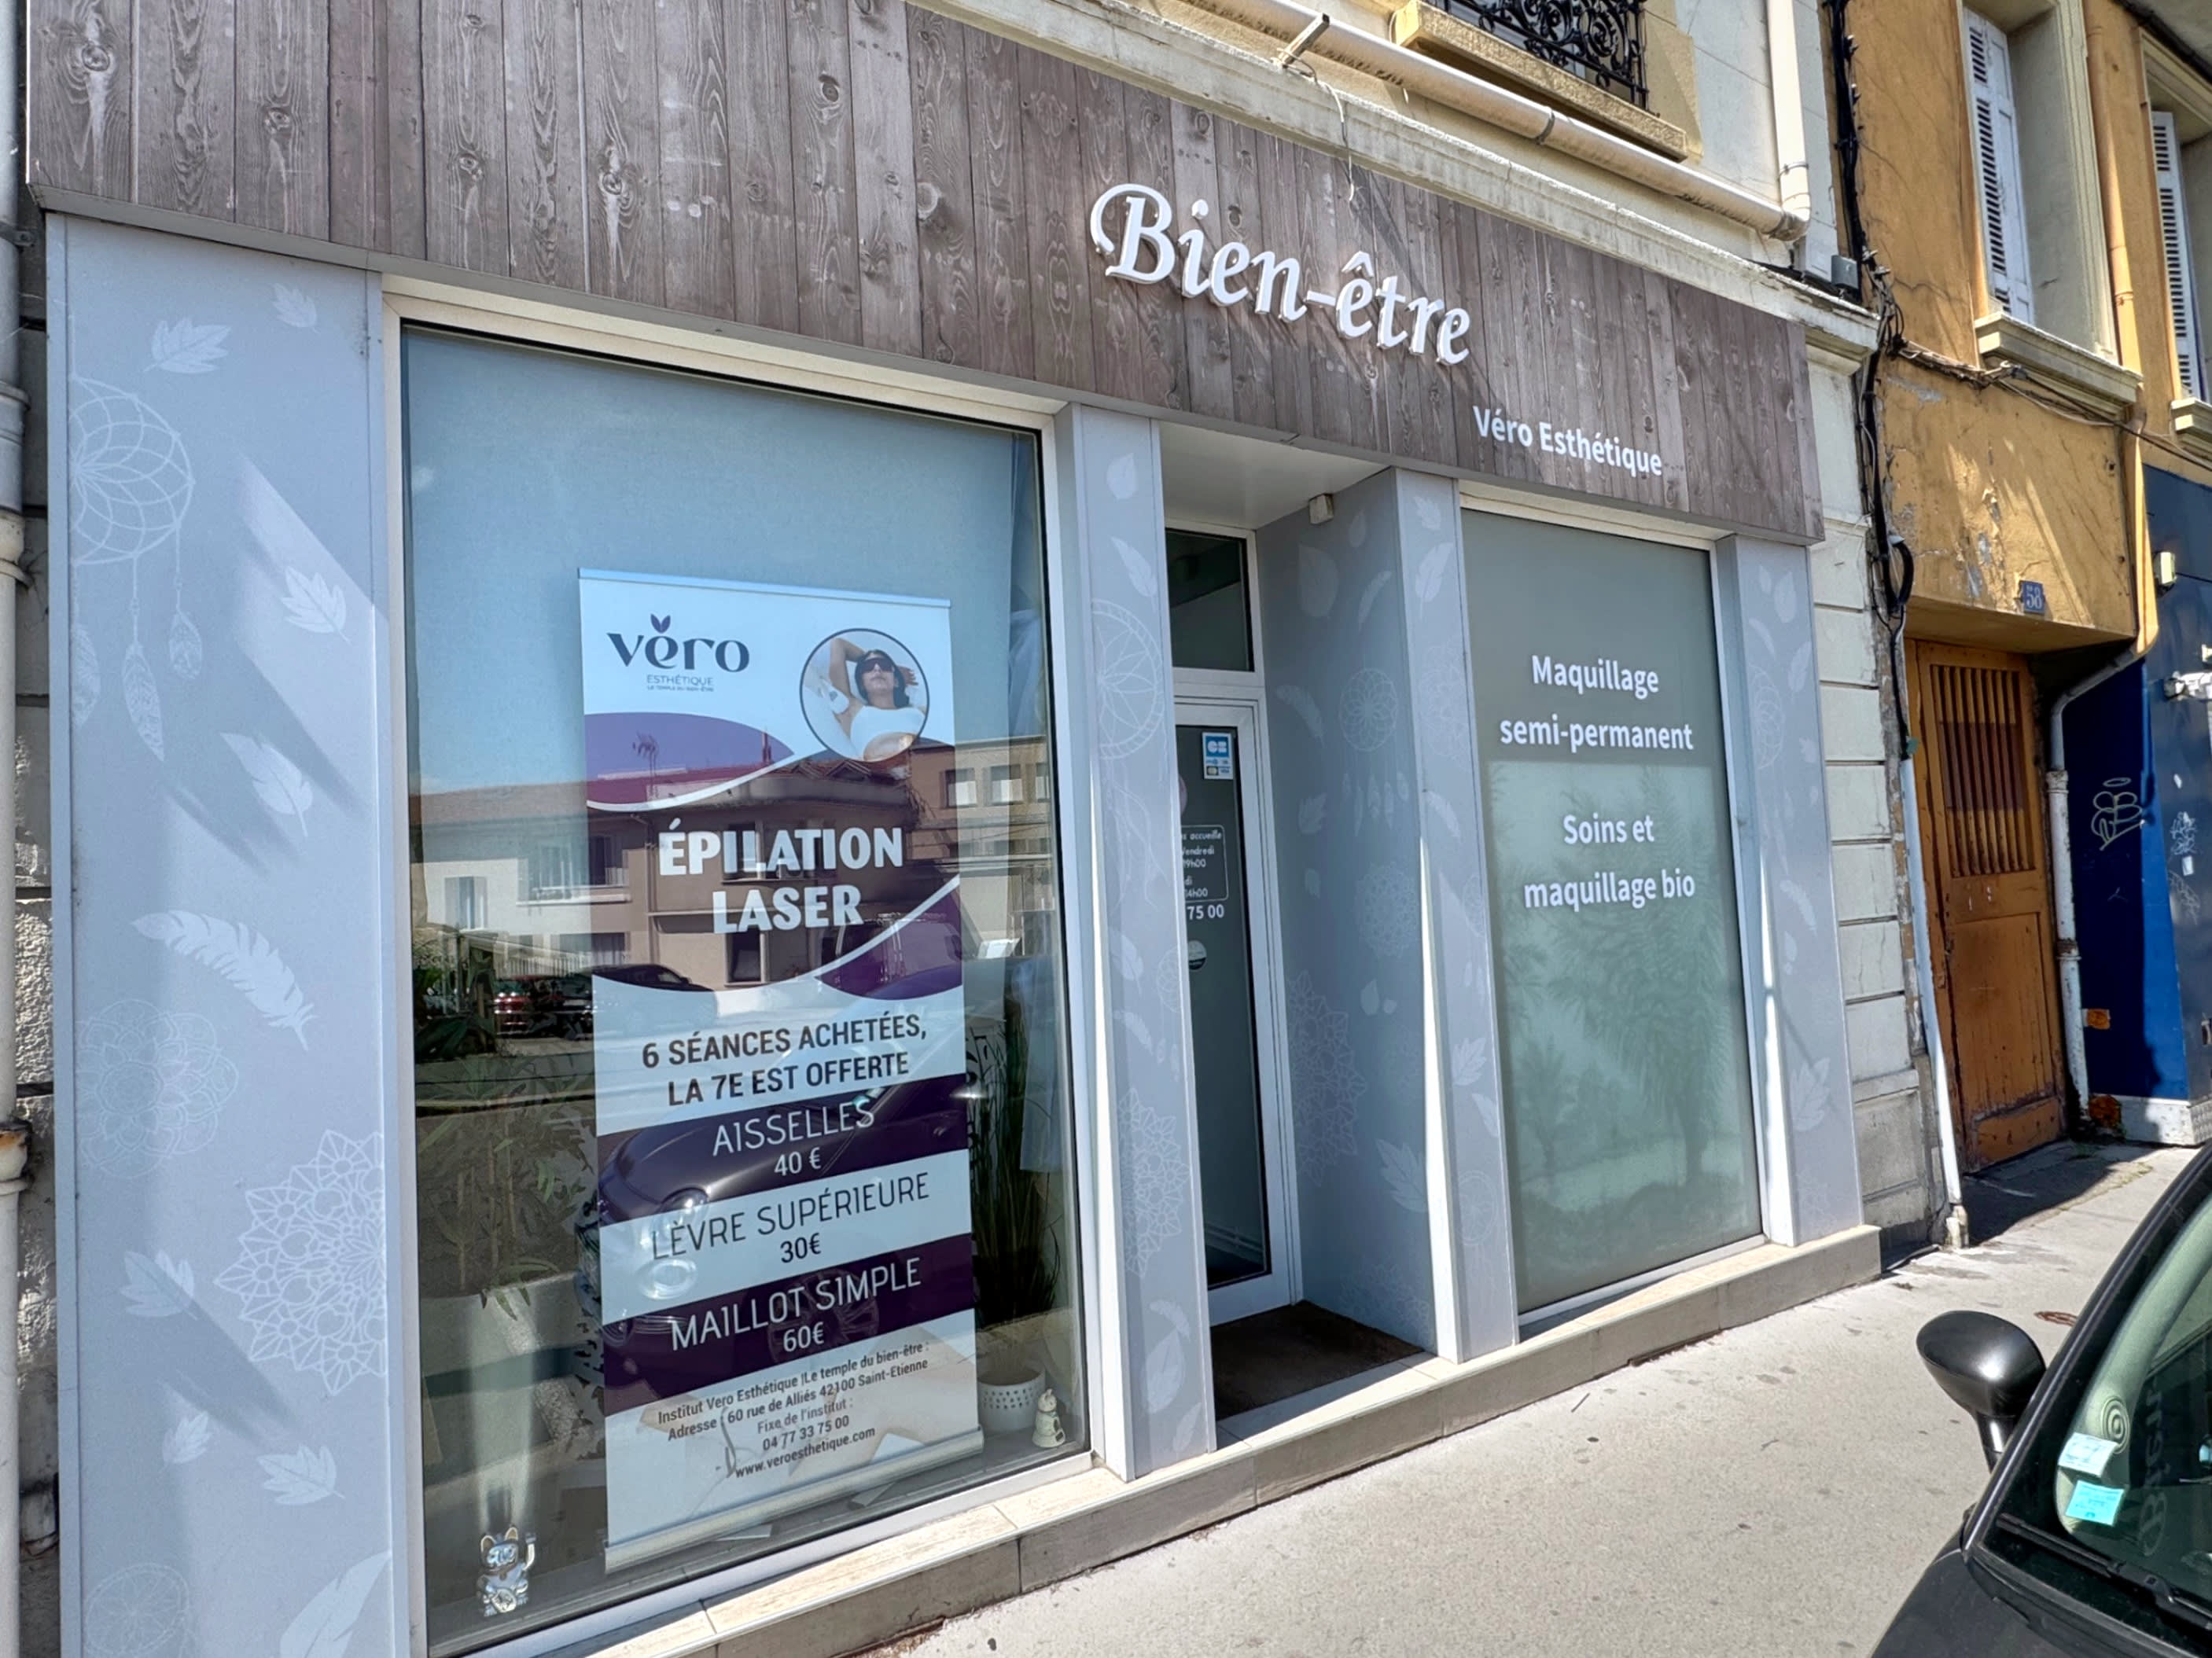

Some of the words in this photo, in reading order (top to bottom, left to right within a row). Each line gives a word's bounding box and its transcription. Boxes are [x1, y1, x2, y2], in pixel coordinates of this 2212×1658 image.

[1090, 183, 1472, 366] Bien-être
[1473, 406, 1533, 447] Véro
[1539, 421, 1662, 477] Esthétique
[2026, 584, 2042, 609] 58
[646, 675, 714, 686] ESTHÉTIQUE
[1532, 655, 1659, 700] Maquillage
[1500, 714, 1694, 753] semi-permanent
[659, 818, 904, 877] ÉPILATION
[1562, 812, 1627, 844] Soins
[1632, 814, 1654, 843] et
[712, 884, 863, 934] LASER
[1187, 905, 1204, 920] 75
[1208, 904, 1224, 918] 00
[1524, 871, 1656, 913] maquillage
[1662, 868, 1695, 899] bio
[642, 1042, 660, 1068] 6
[668, 1028, 791, 1066] SÉANCES
[799, 1011, 927, 1050] ACHETÉES,
[668, 1078, 703, 1105] LA
[711, 1073, 744, 1101] 7E
[752, 1066, 798, 1095] EST
[806, 1052, 909, 1087] OFFERTE
[712, 1100, 875, 1156] AISSELLES
[775, 1150, 800, 1176] 40
[652, 1211, 745, 1260] LÈVRE
[756, 1171, 930, 1234] SUPÉRIEURE
[779, 1233, 823, 1263] 30€
[671, 1286, 807, 1351] MAILLOT
[816, 1258, 922, 1310] SIMPLE
[783, 1320, 825, 1352] 60€
[658, 1401, 704, 1425] Institut
[706, 1395, 734, 1411] Vero
[737, 1376, 798, 1402] Esthétique
[820, 1359, 858, 1380] temple
[860, 1355, 874, 1369] du
[876, 1343, 923, 1364] bien-être
[668, 1418, 717, 1441] Adresse
[727, 1409, 743, 1424] 60
[747, 1406, 765, 1419] rue
[768, 1399, 782, 1413] de
[786, 1389, 816, 1408] Alliés
[819, 1377, 856, 1397] 42100
[858, 1358, 928, 1387] Saint-Etienne
[762, 1436, 778, 1451] 04
[782, 1431, 796, 1447] 77
[799, 1425, 814, 1440] 33
[818, 1421, 832, 1434] 75
[834, 1415, 849, 1430] 00
[785, 1412, 798, 1426] de
[735, 1427, 876, 1478] www.veroesthetique.com
